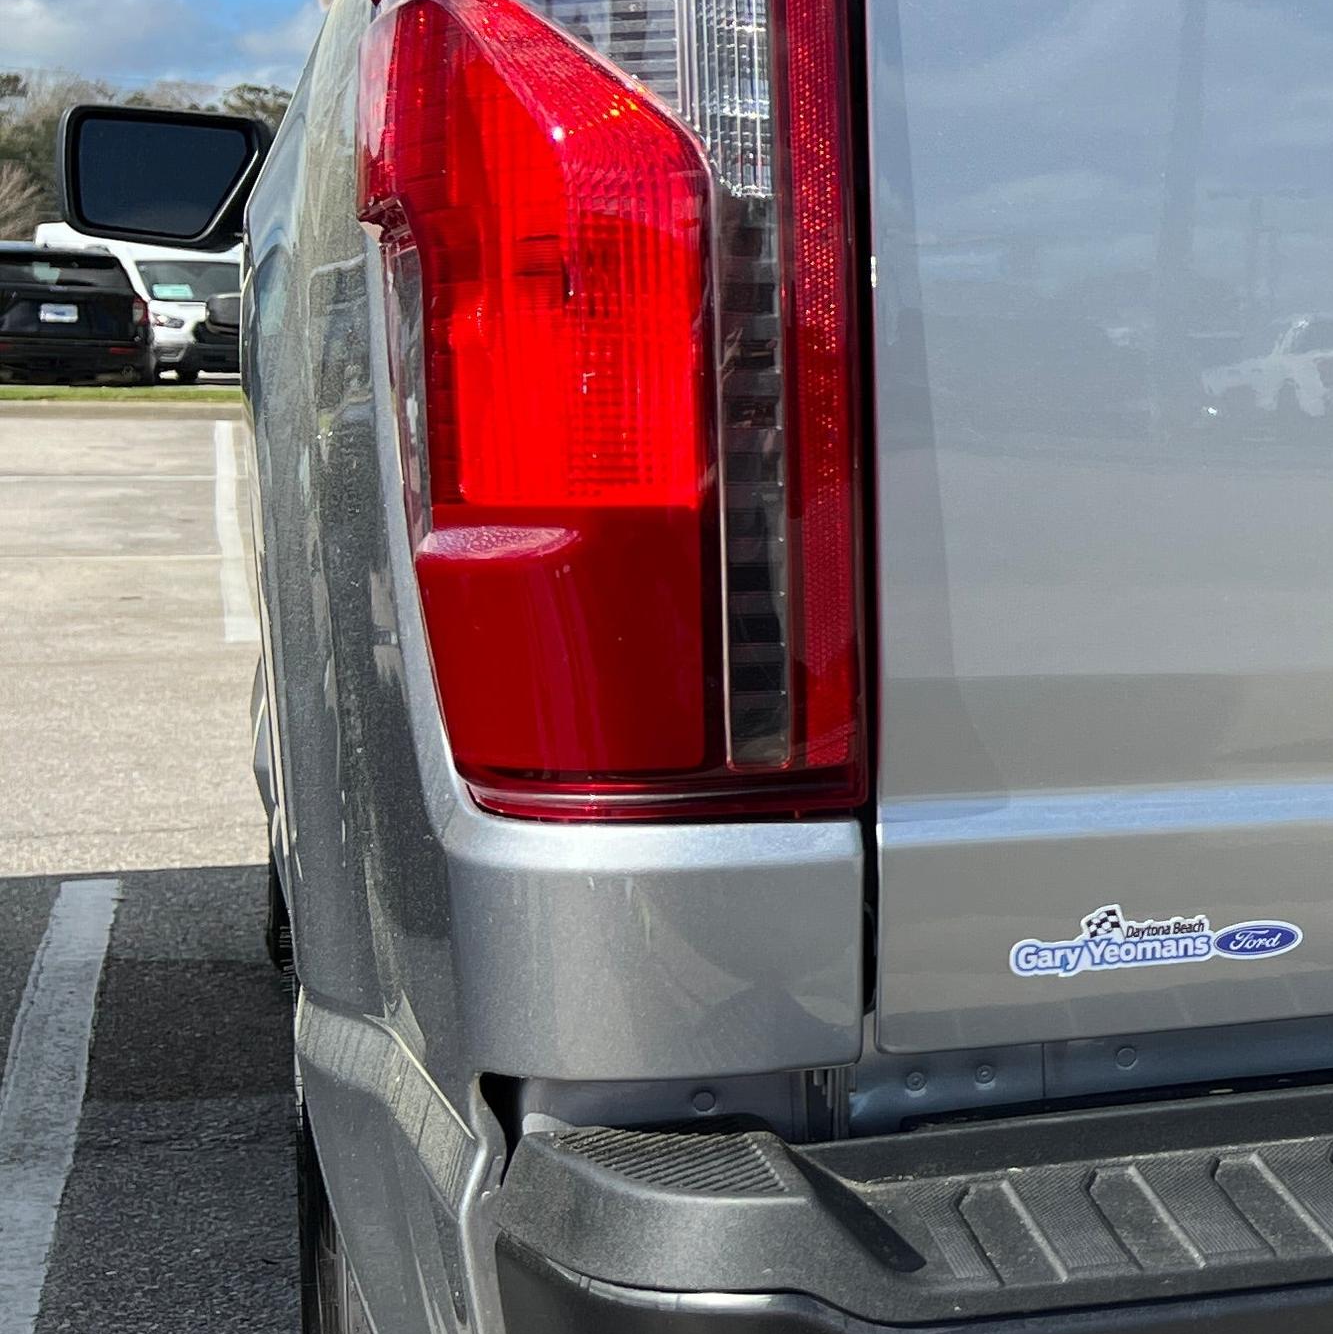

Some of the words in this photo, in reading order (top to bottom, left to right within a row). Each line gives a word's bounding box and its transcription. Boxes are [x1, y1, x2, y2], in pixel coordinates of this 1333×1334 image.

[1126, 923, 1171, 940] Daytona
[1172, 919, 1205, 935] Beach
[1015, 945, 1082, 972] Gary
[1087, 934, 1210, 965] Yeomans
[1229, 929, 1283, 951] Ford
